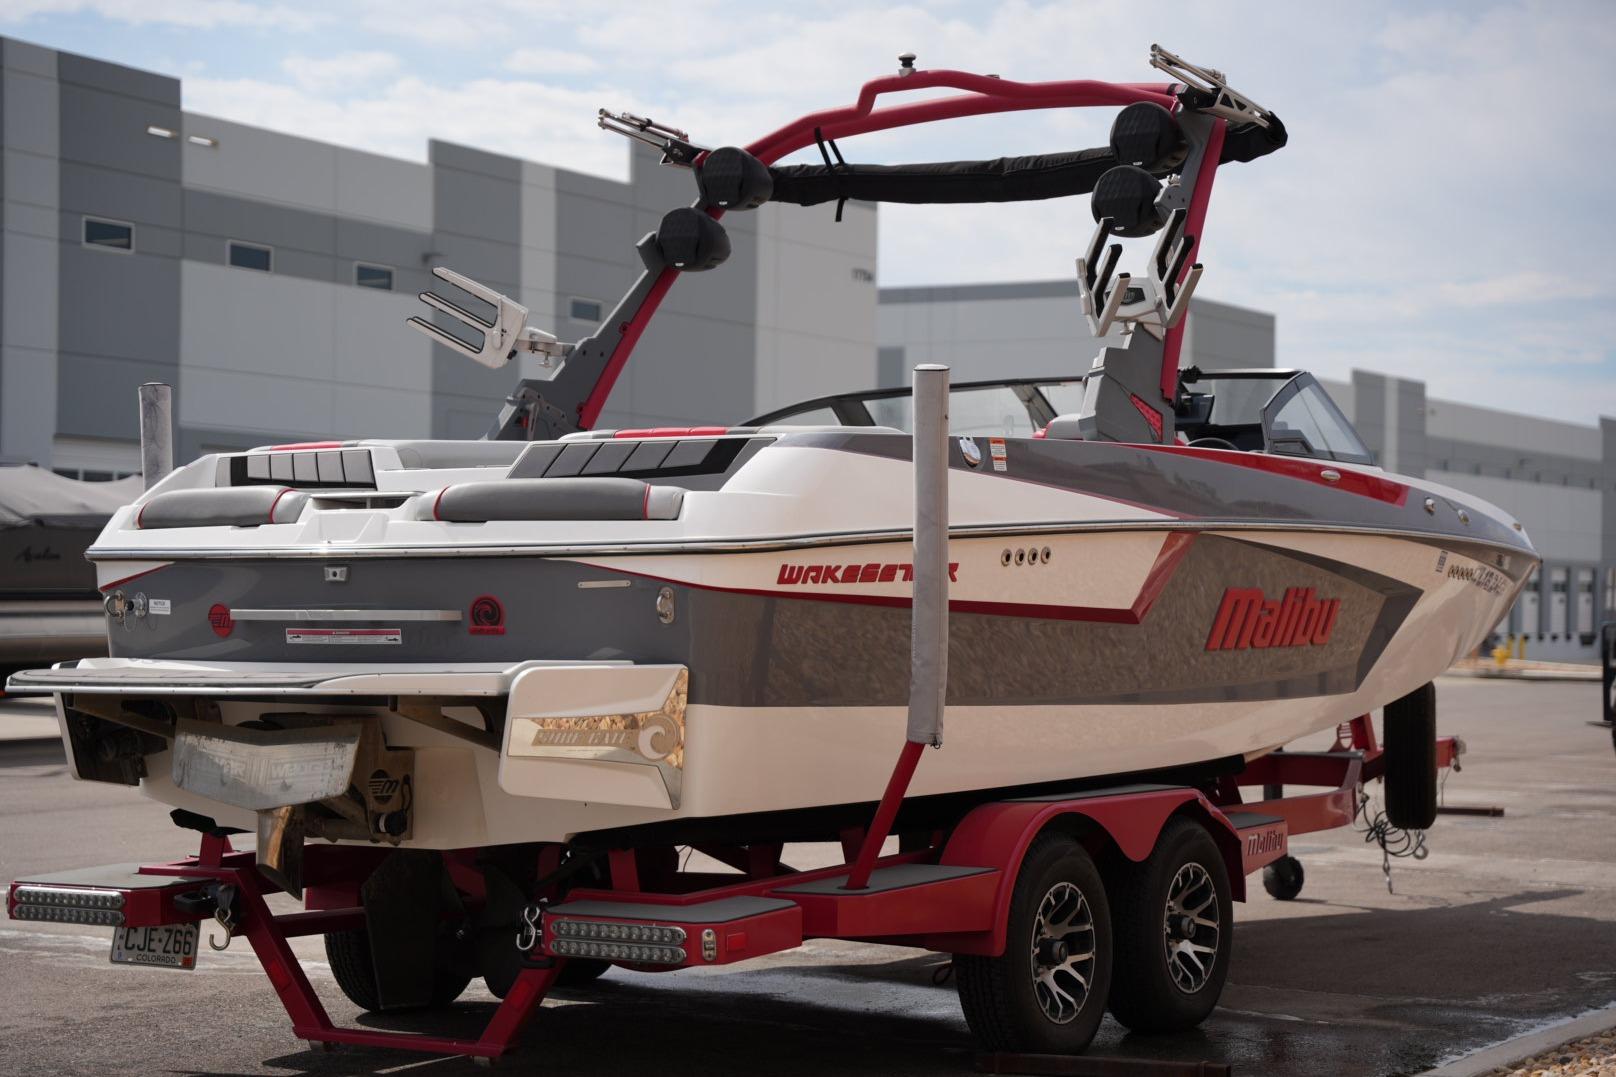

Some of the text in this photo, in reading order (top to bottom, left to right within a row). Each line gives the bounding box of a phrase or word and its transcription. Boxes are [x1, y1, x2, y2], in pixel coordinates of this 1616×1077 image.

[777, 563, 959, 585] WAKESETR
[1206, 587, 1341, 650] Malibu
[1247, 830, 1284, 856] Malibu
[135, 953, 177, 964] COLORADO
